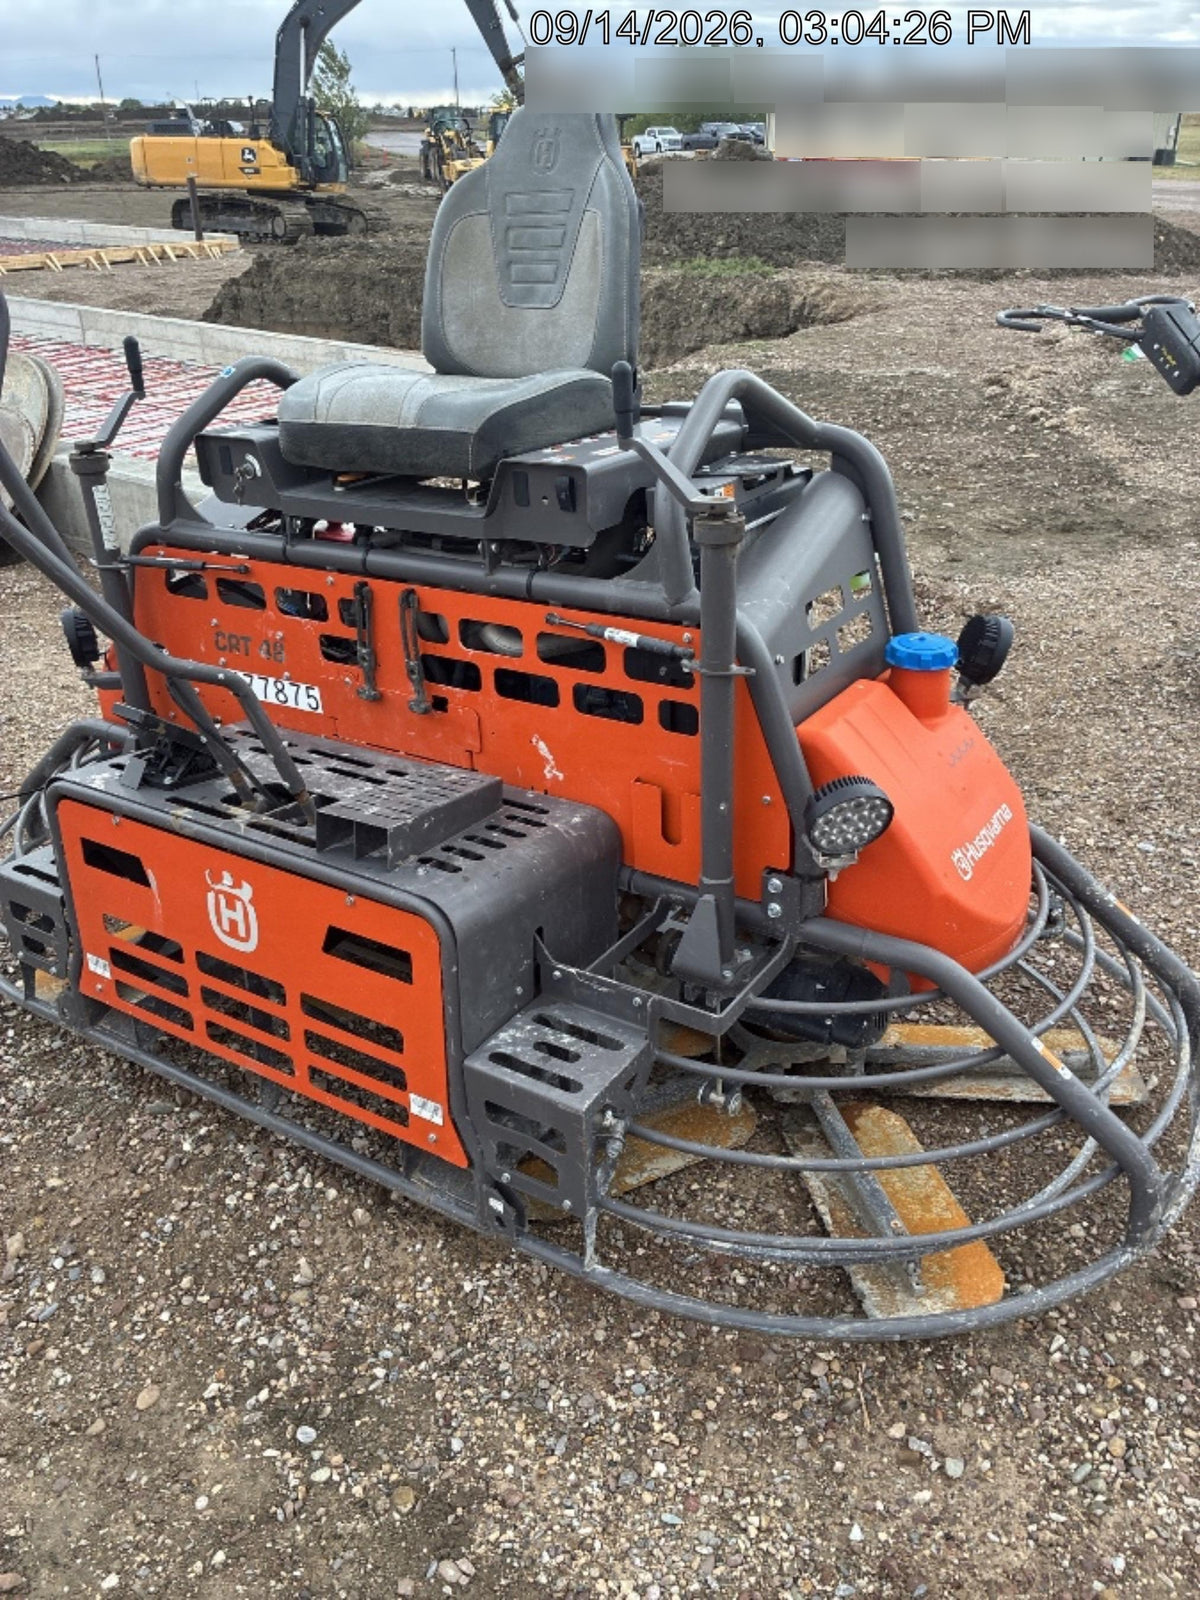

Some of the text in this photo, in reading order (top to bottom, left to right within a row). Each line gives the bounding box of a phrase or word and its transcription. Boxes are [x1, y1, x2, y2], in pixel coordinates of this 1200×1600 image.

[214, 630, 286, 665] CRT 48
[233, 671, 319, 711] 77875
[961, 803, 1013, 868] Husqvarna
